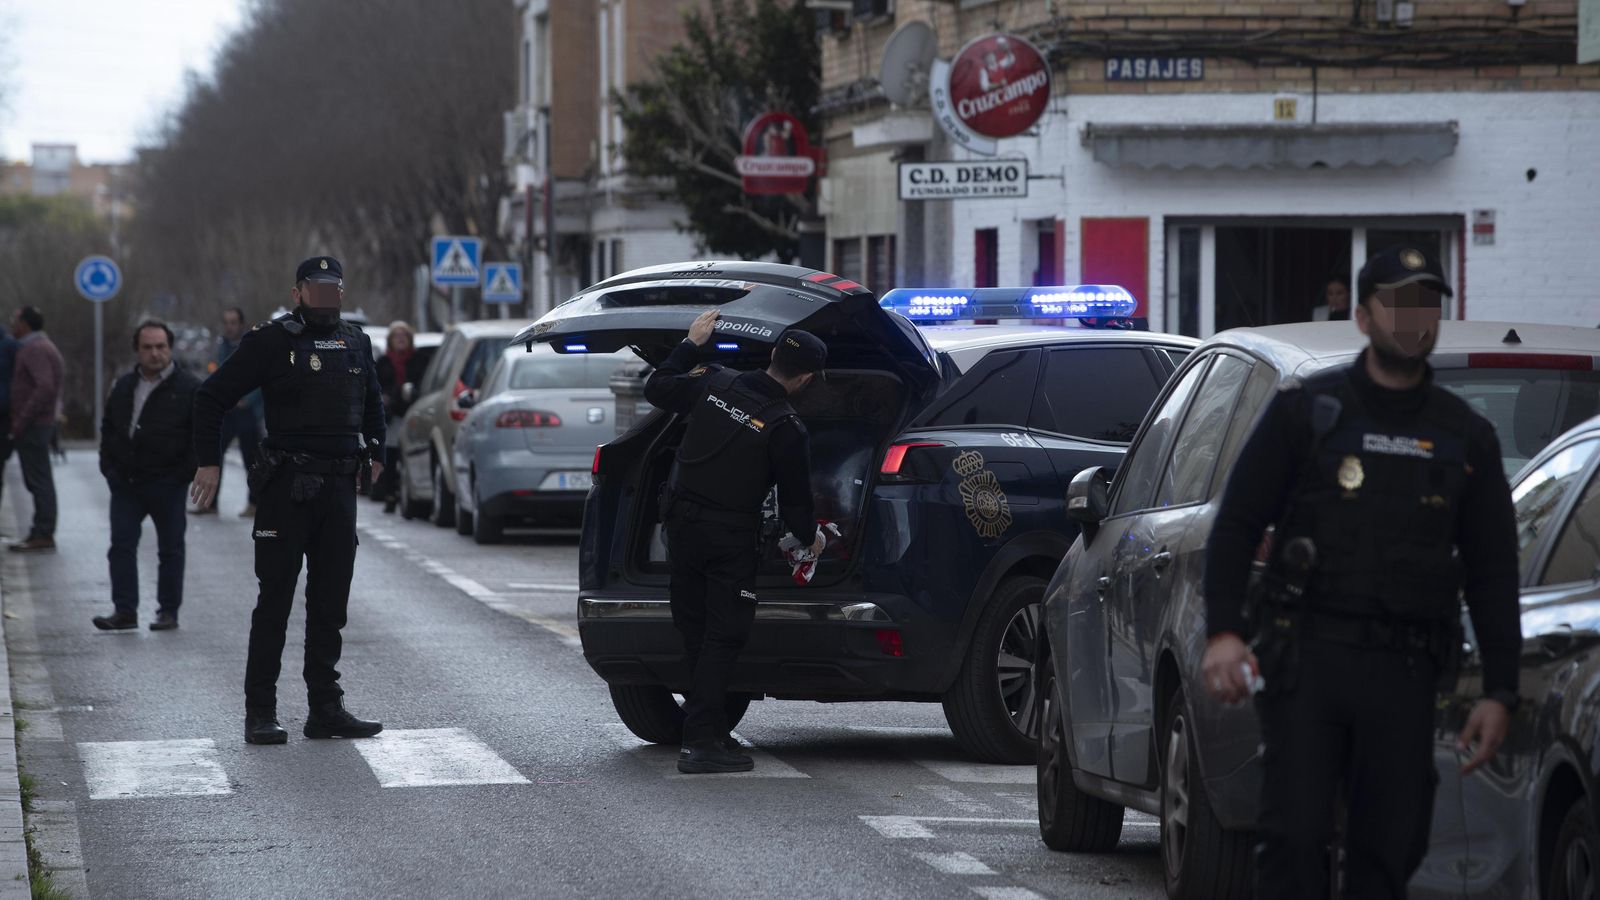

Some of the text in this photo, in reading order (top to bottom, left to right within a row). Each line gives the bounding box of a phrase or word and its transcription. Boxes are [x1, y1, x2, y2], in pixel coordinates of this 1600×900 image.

[1107, 58, 1203, 79] PASAJES
[958, 70, 1048, 119] Cruzcampo
[943, 115, 970, 143] DEMO
[742, 161, 807, 175] Cruzcampo
[909, 166, 1019, 184] C.D. DEMO
[910, 186, 969, 195] FUNDADO
[715, 319, 773, 338] @policia
[786, 337, 800, 348] CNP
[707, 394, 750, 421] POLICIA
[730, 413, 761, 433] NACNAL
